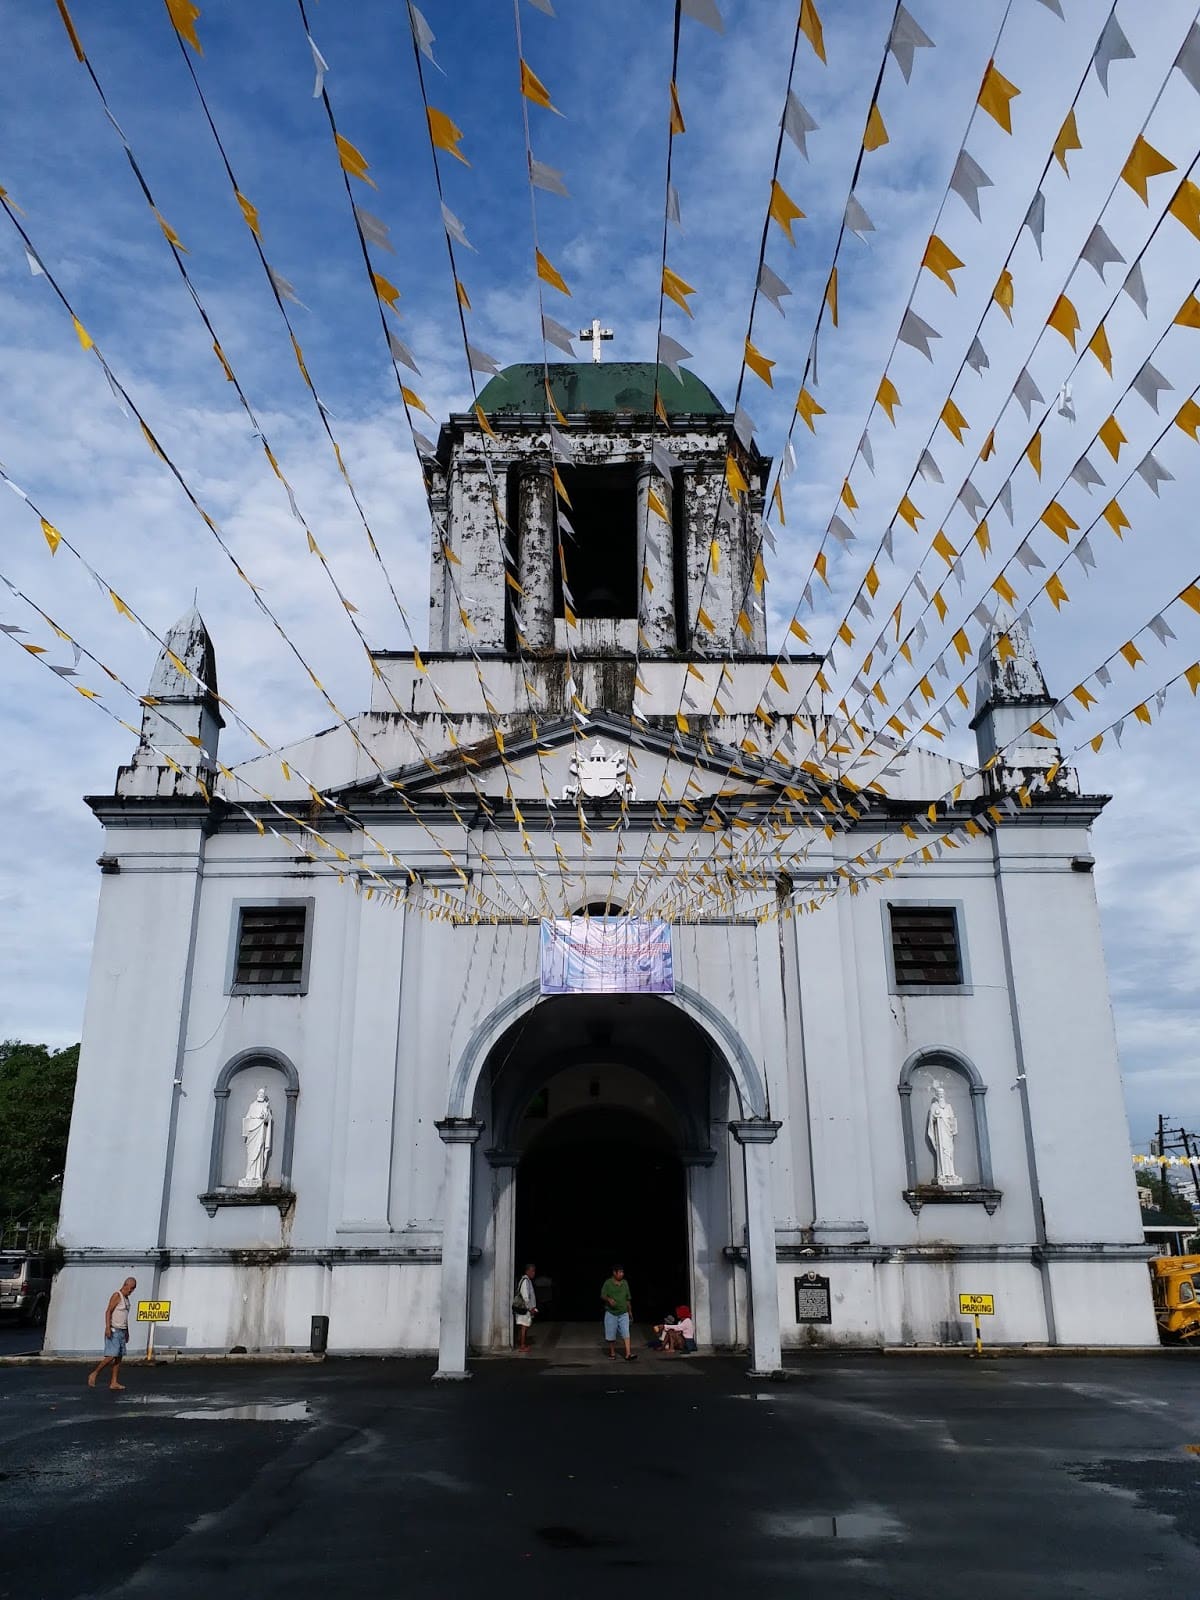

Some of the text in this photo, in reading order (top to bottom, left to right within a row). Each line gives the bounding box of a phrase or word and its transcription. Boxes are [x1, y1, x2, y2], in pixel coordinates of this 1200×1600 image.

[970, 1296, 983, 1304] NO
[148, 1302, 161, 1310] NO
[962, 1304, 992, 1312] PARKING
[138, 1311, 169, 1319] PARKING
